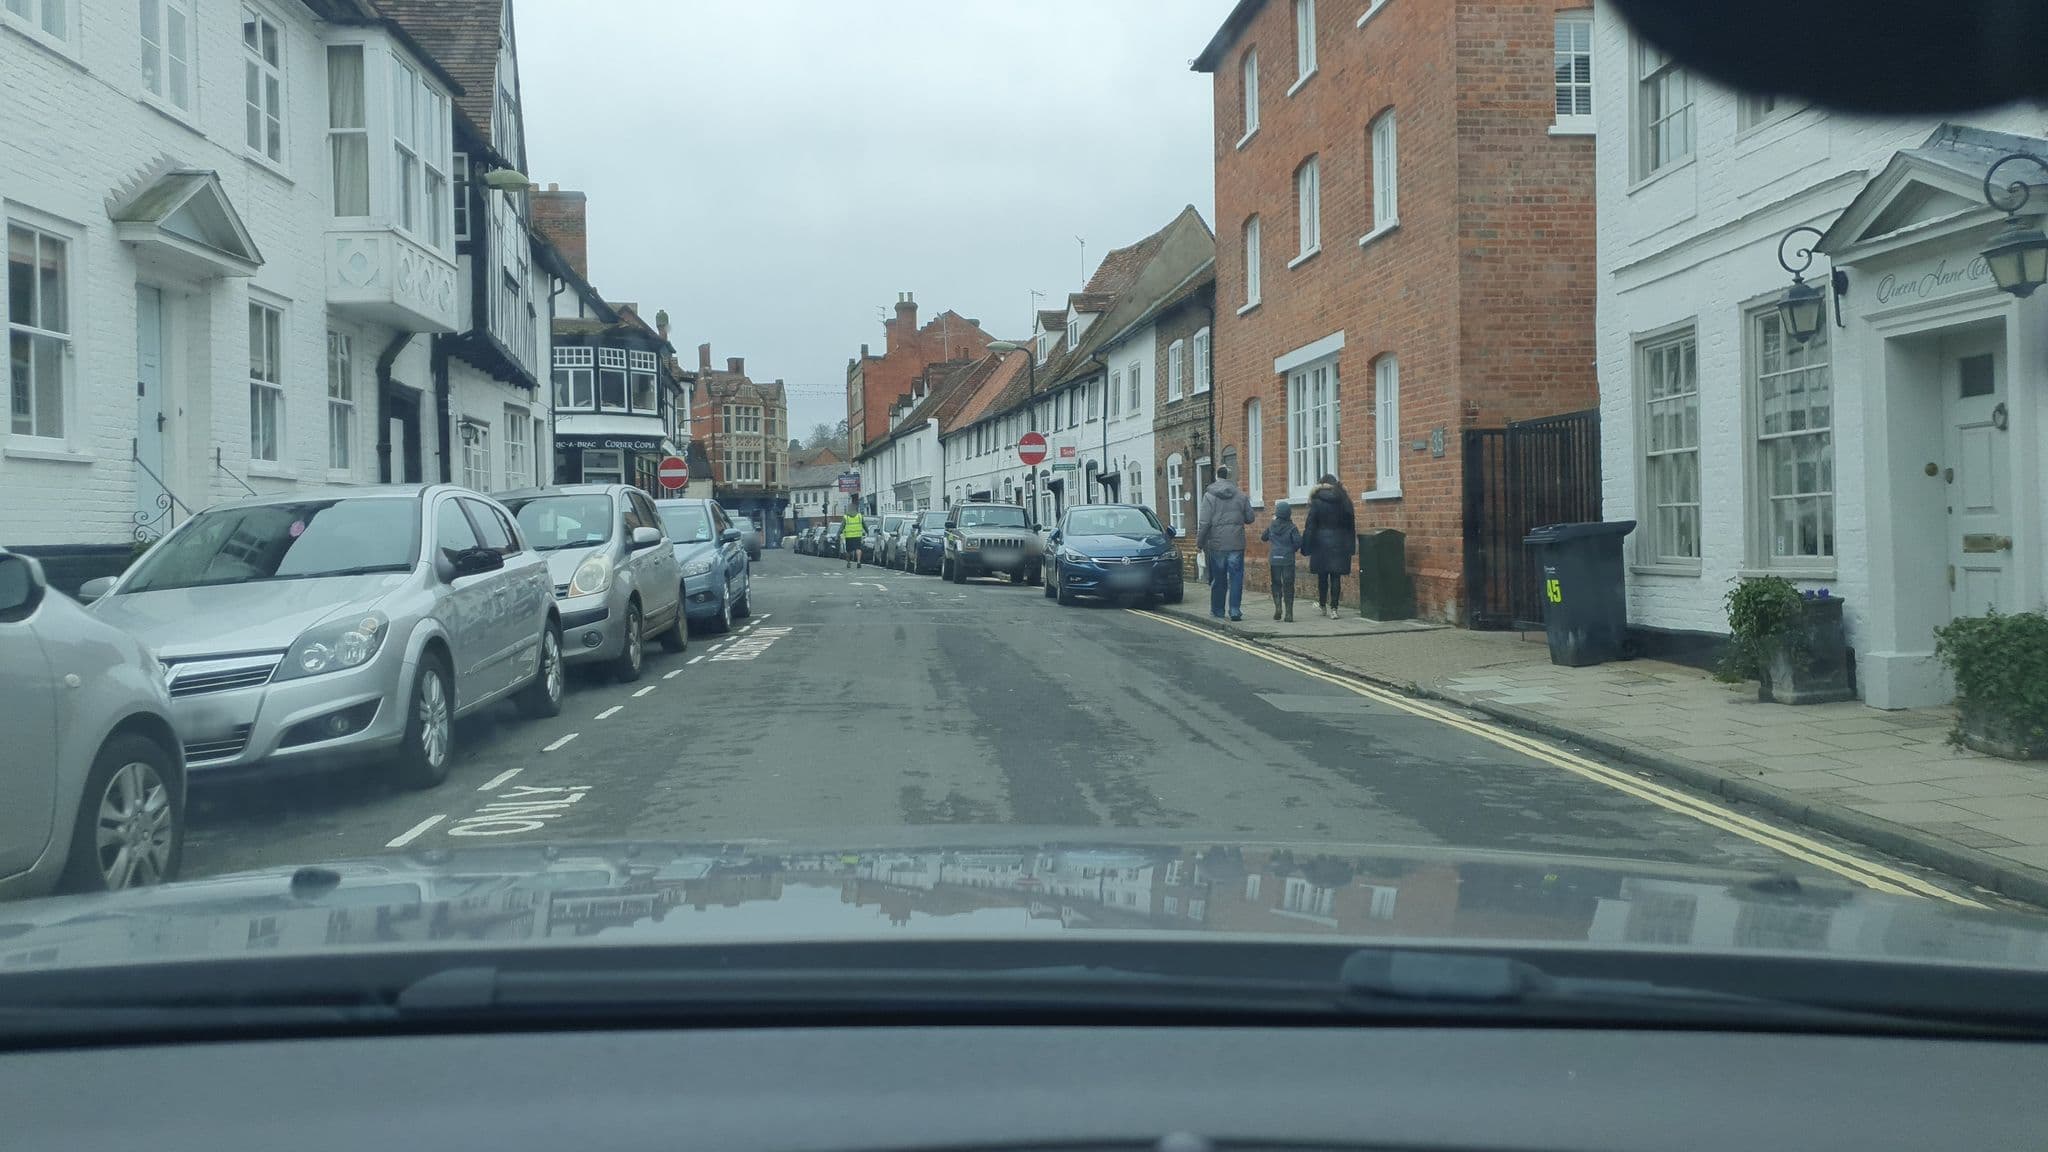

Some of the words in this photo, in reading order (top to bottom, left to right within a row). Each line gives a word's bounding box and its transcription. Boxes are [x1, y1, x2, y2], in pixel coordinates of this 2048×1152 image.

[1876, 274, 1917, 304] Queen
[1918, 259, 1965, 298] Anne
[1546, 579, 1562, 603] 45
[447, 785, 593, 836] ONLY
